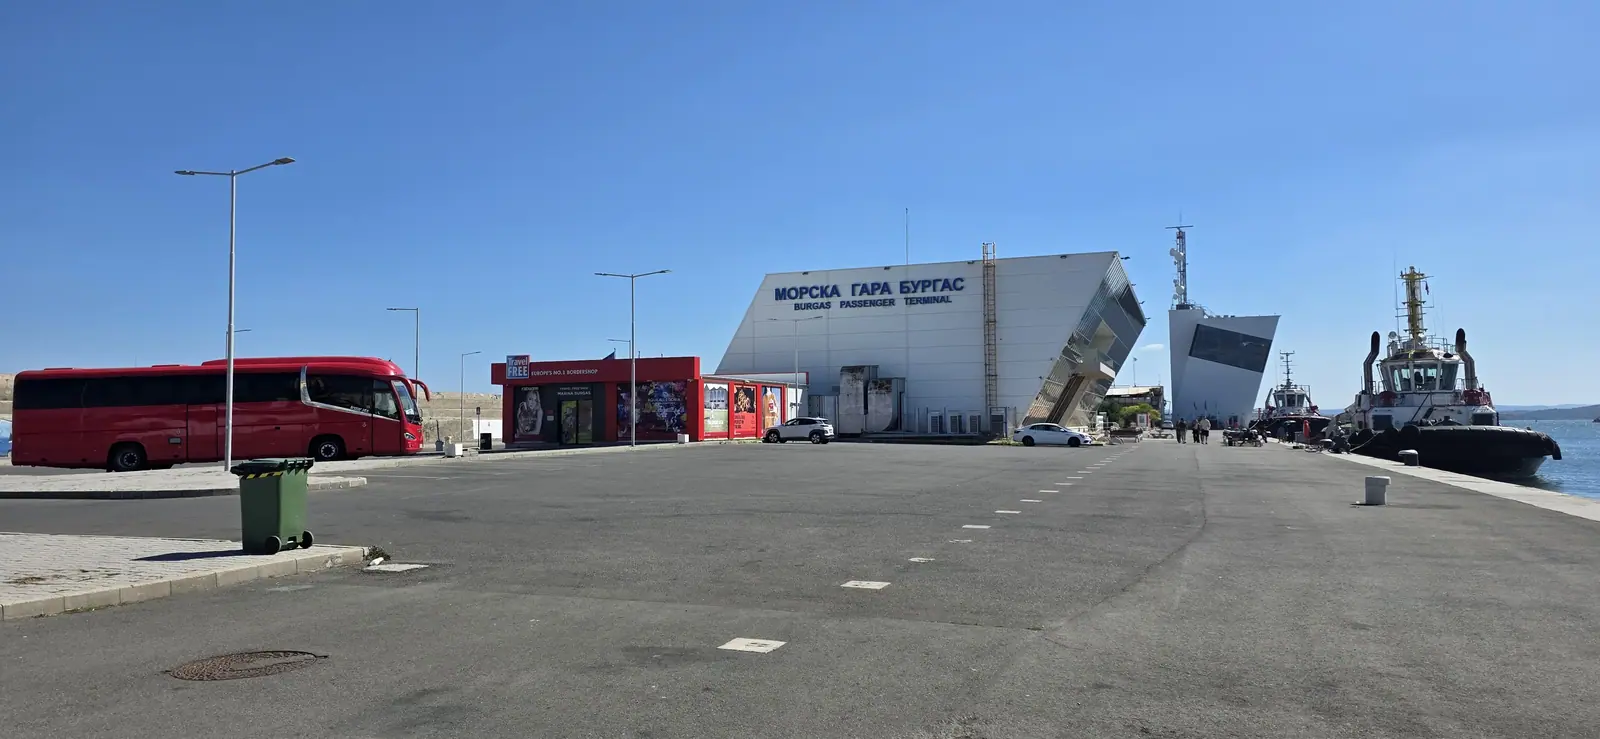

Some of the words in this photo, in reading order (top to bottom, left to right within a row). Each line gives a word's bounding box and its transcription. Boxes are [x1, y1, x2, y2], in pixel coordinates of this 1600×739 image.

[774, 284, 841, 301] МОРСКА
[851, 281, 892, 297] ГАРА
[899, 277, 965, 294] БУРГАС
[794, 301, 831, 311] BURGAS
[839, 298, 896, 309] PASSENGER
[904, 295, 952, 306] TERMINAL
[508, 357, 528, 366] Travel
[507, 366, 528, 377] FREE
